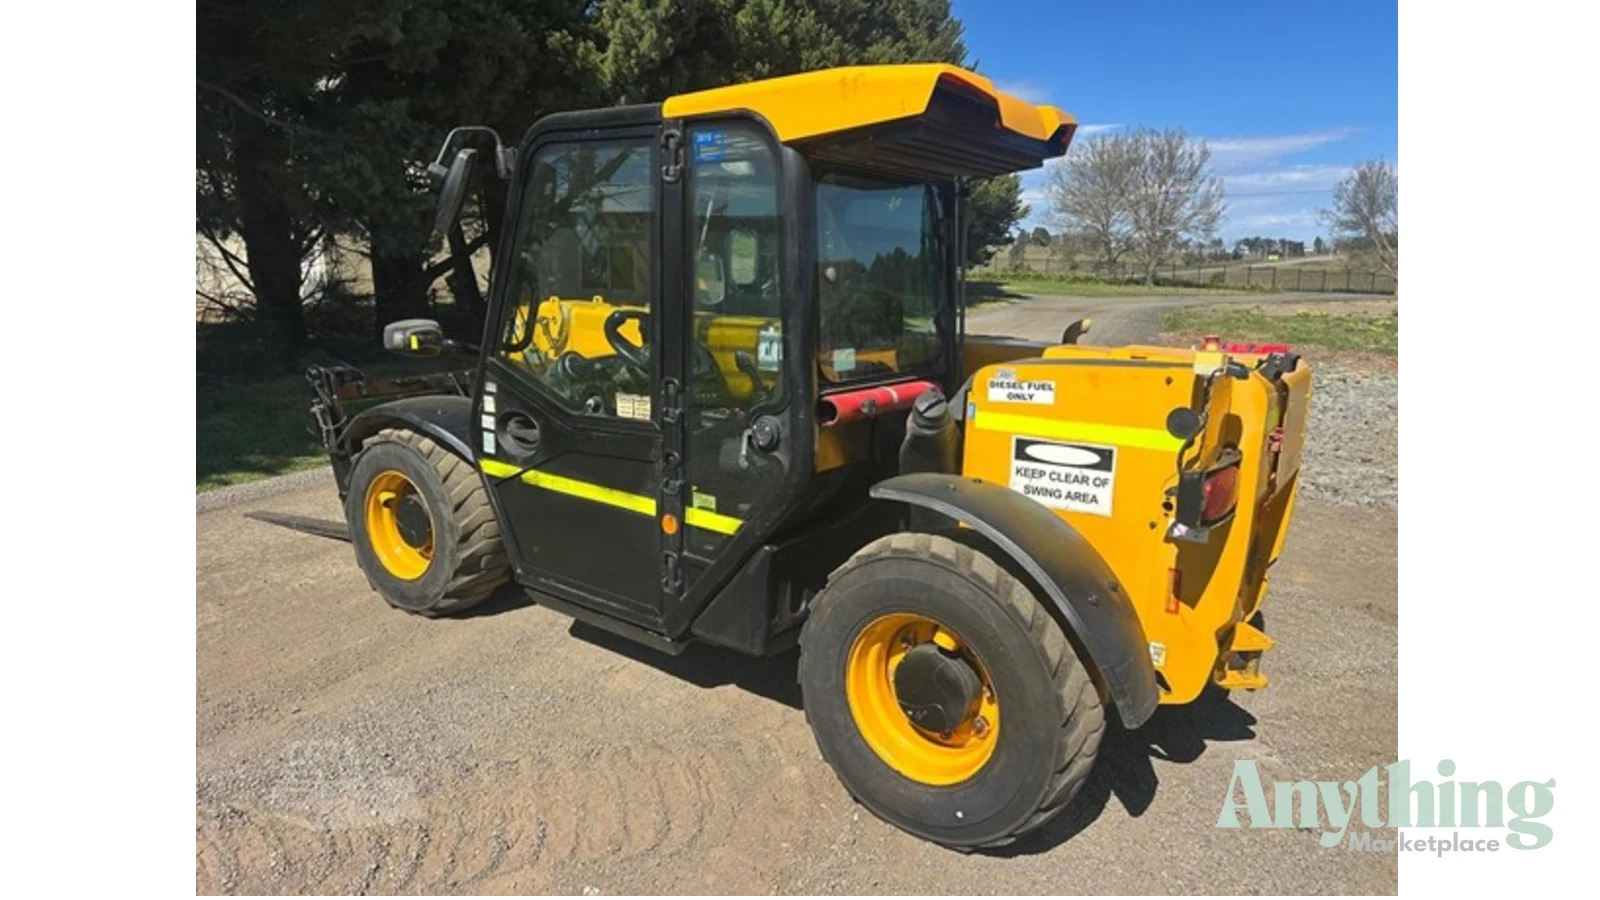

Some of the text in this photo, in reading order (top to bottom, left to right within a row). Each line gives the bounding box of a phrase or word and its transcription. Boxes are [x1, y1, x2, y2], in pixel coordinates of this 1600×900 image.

[989, 380, 1054, 391] DIESEL FUEL
[1007, 392, 1035, 401] ONLY
[1016, 466, 1110, 488] KEEP CLEAR OF
[1024, 484, 1099, 504] SWING AREA
